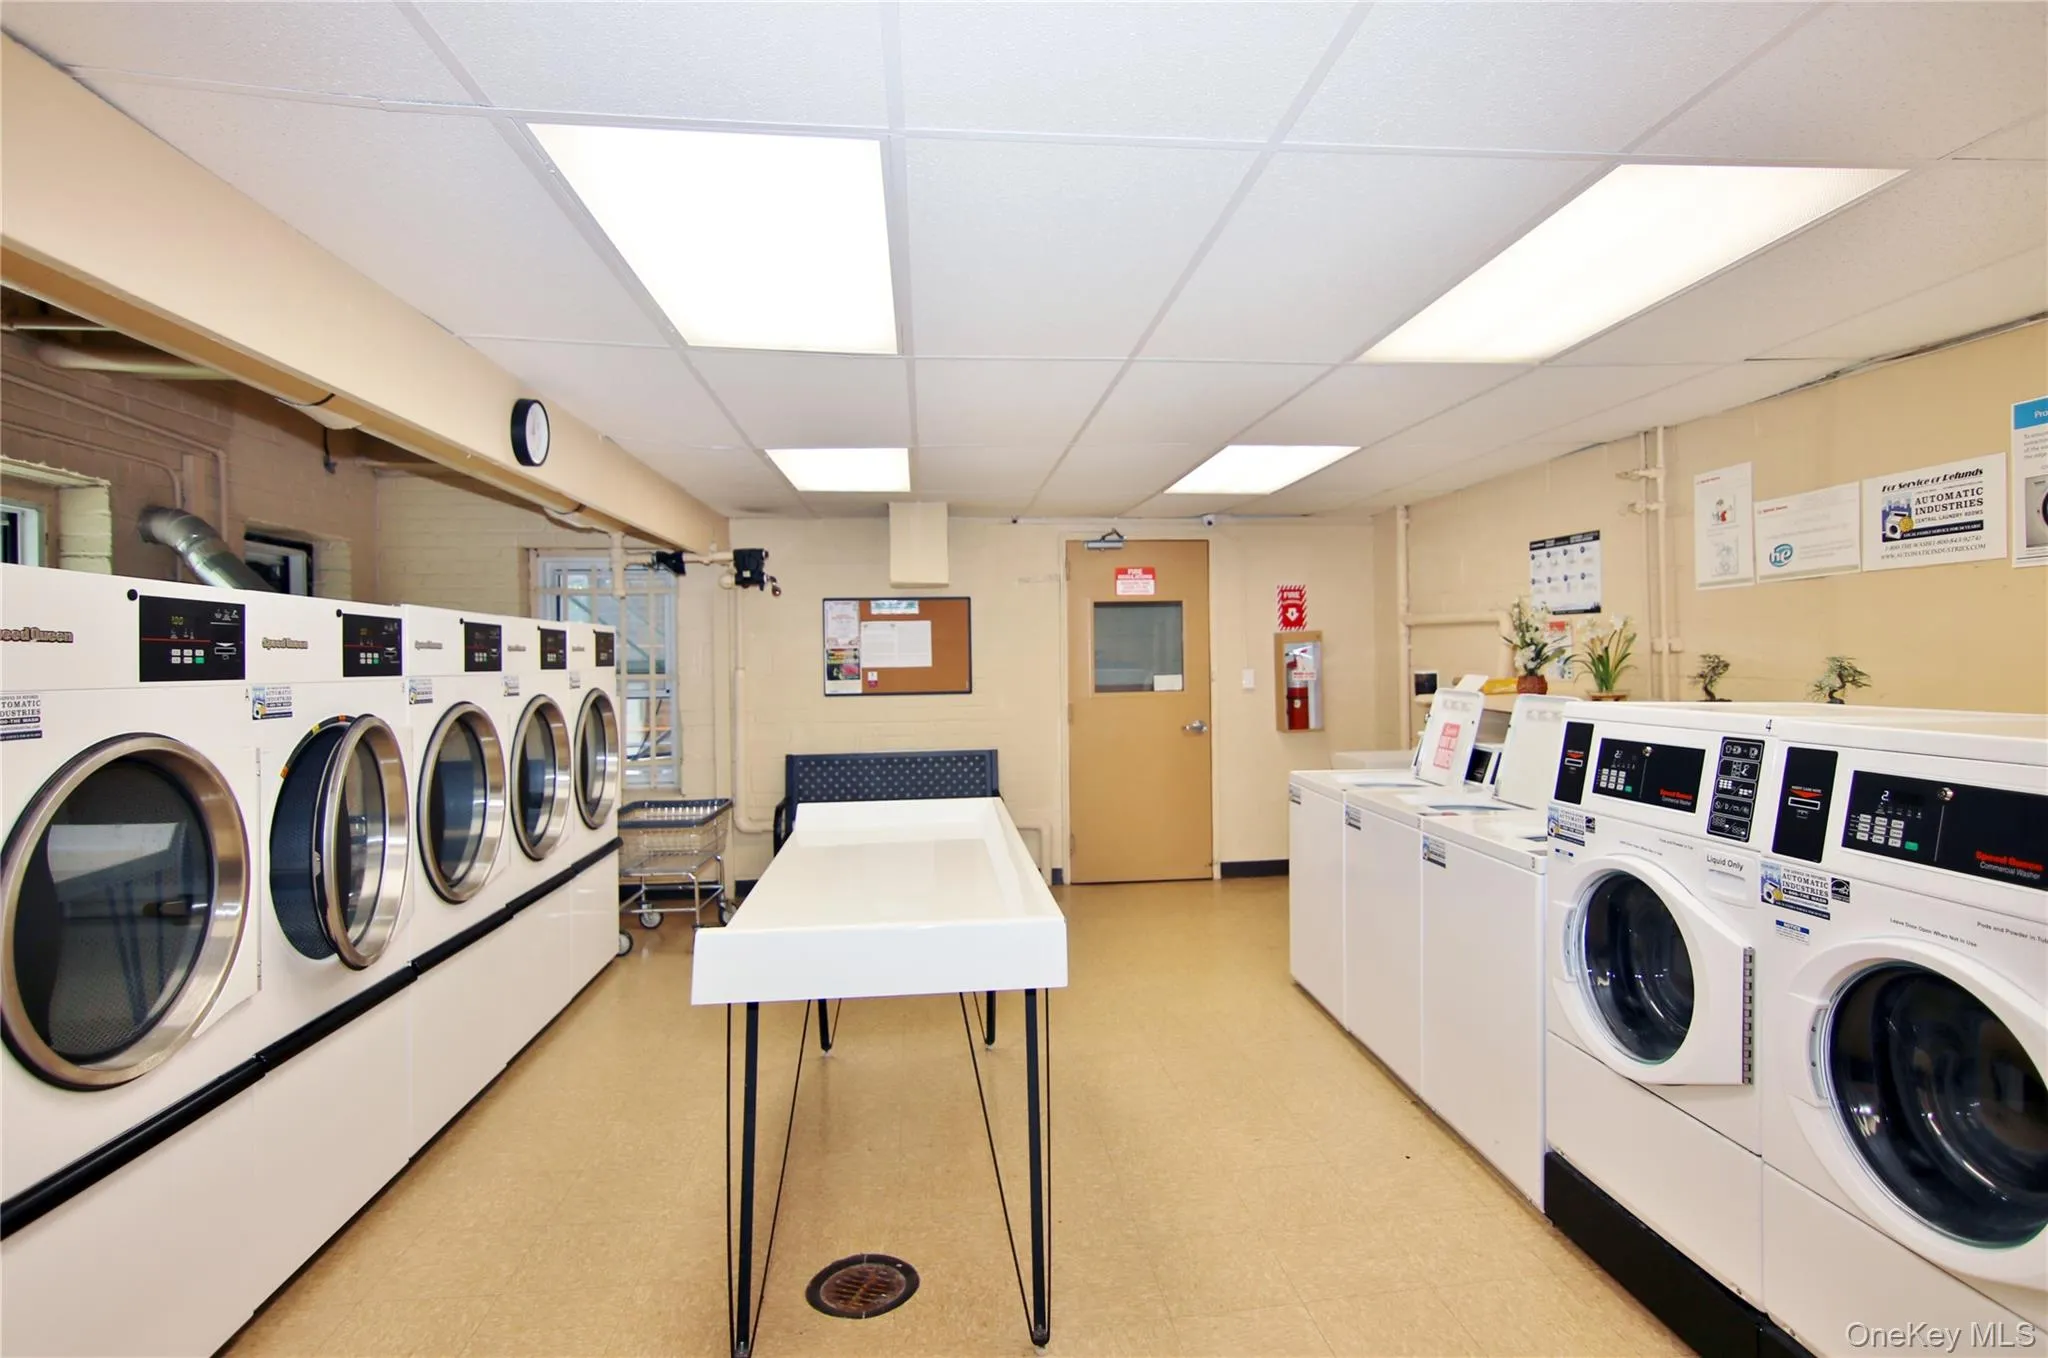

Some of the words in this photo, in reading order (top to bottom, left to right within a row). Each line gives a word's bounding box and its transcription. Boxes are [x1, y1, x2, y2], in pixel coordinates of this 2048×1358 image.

[1882, 484, 1897, 492] For
[1898, 477, 1930, 489] Service
[1931, 475, 1942, 484] or
[1942, 467, 1983, 482] Refunds
[1914, 487, 1984, 505] AUTOMATIC
[1915, 497, 1984, 516] INDUSTRIES
[1707, 854, 1726, 866] Liquid
[1727, 859, 1744, 872] Only
[1980, 861, 2016, 875] Commercial
[2016, 867, 2040, 880] Washer
[1782, 872, 1829, 889] AUTOMATIC
[1782, 880, 1829, 897] INDUSTRIES
[1993, 924, 2004, 933] and
[2005, 928, 2028, 939] Powder
